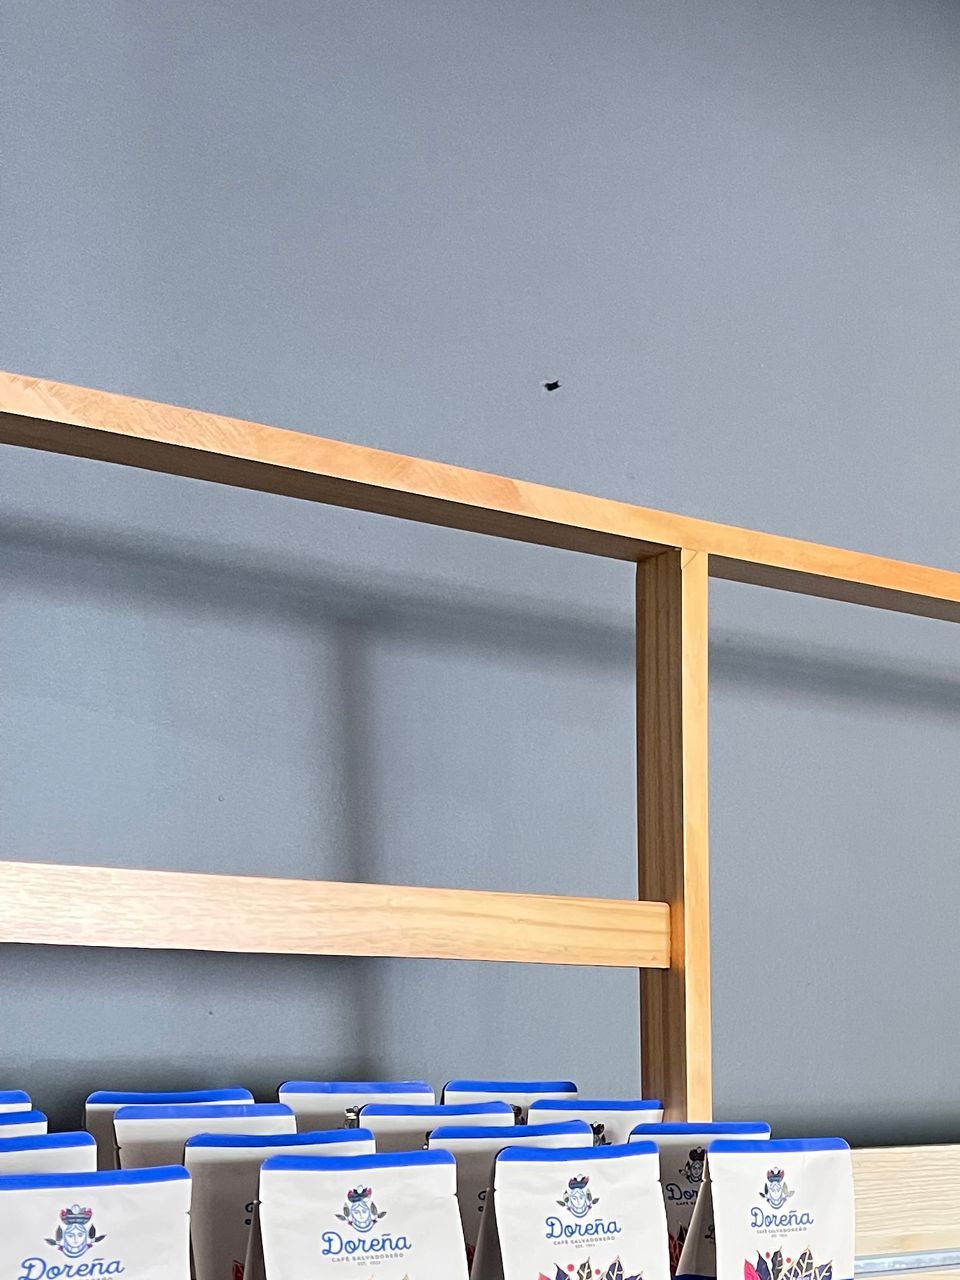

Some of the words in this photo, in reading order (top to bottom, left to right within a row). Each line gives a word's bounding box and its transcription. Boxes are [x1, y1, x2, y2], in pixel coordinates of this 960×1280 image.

[545, 1216, 622, 1239] Doreña
[750, 1207, 814, 1228] Doreña
[322, 1231, 413, 1256] Doreña
